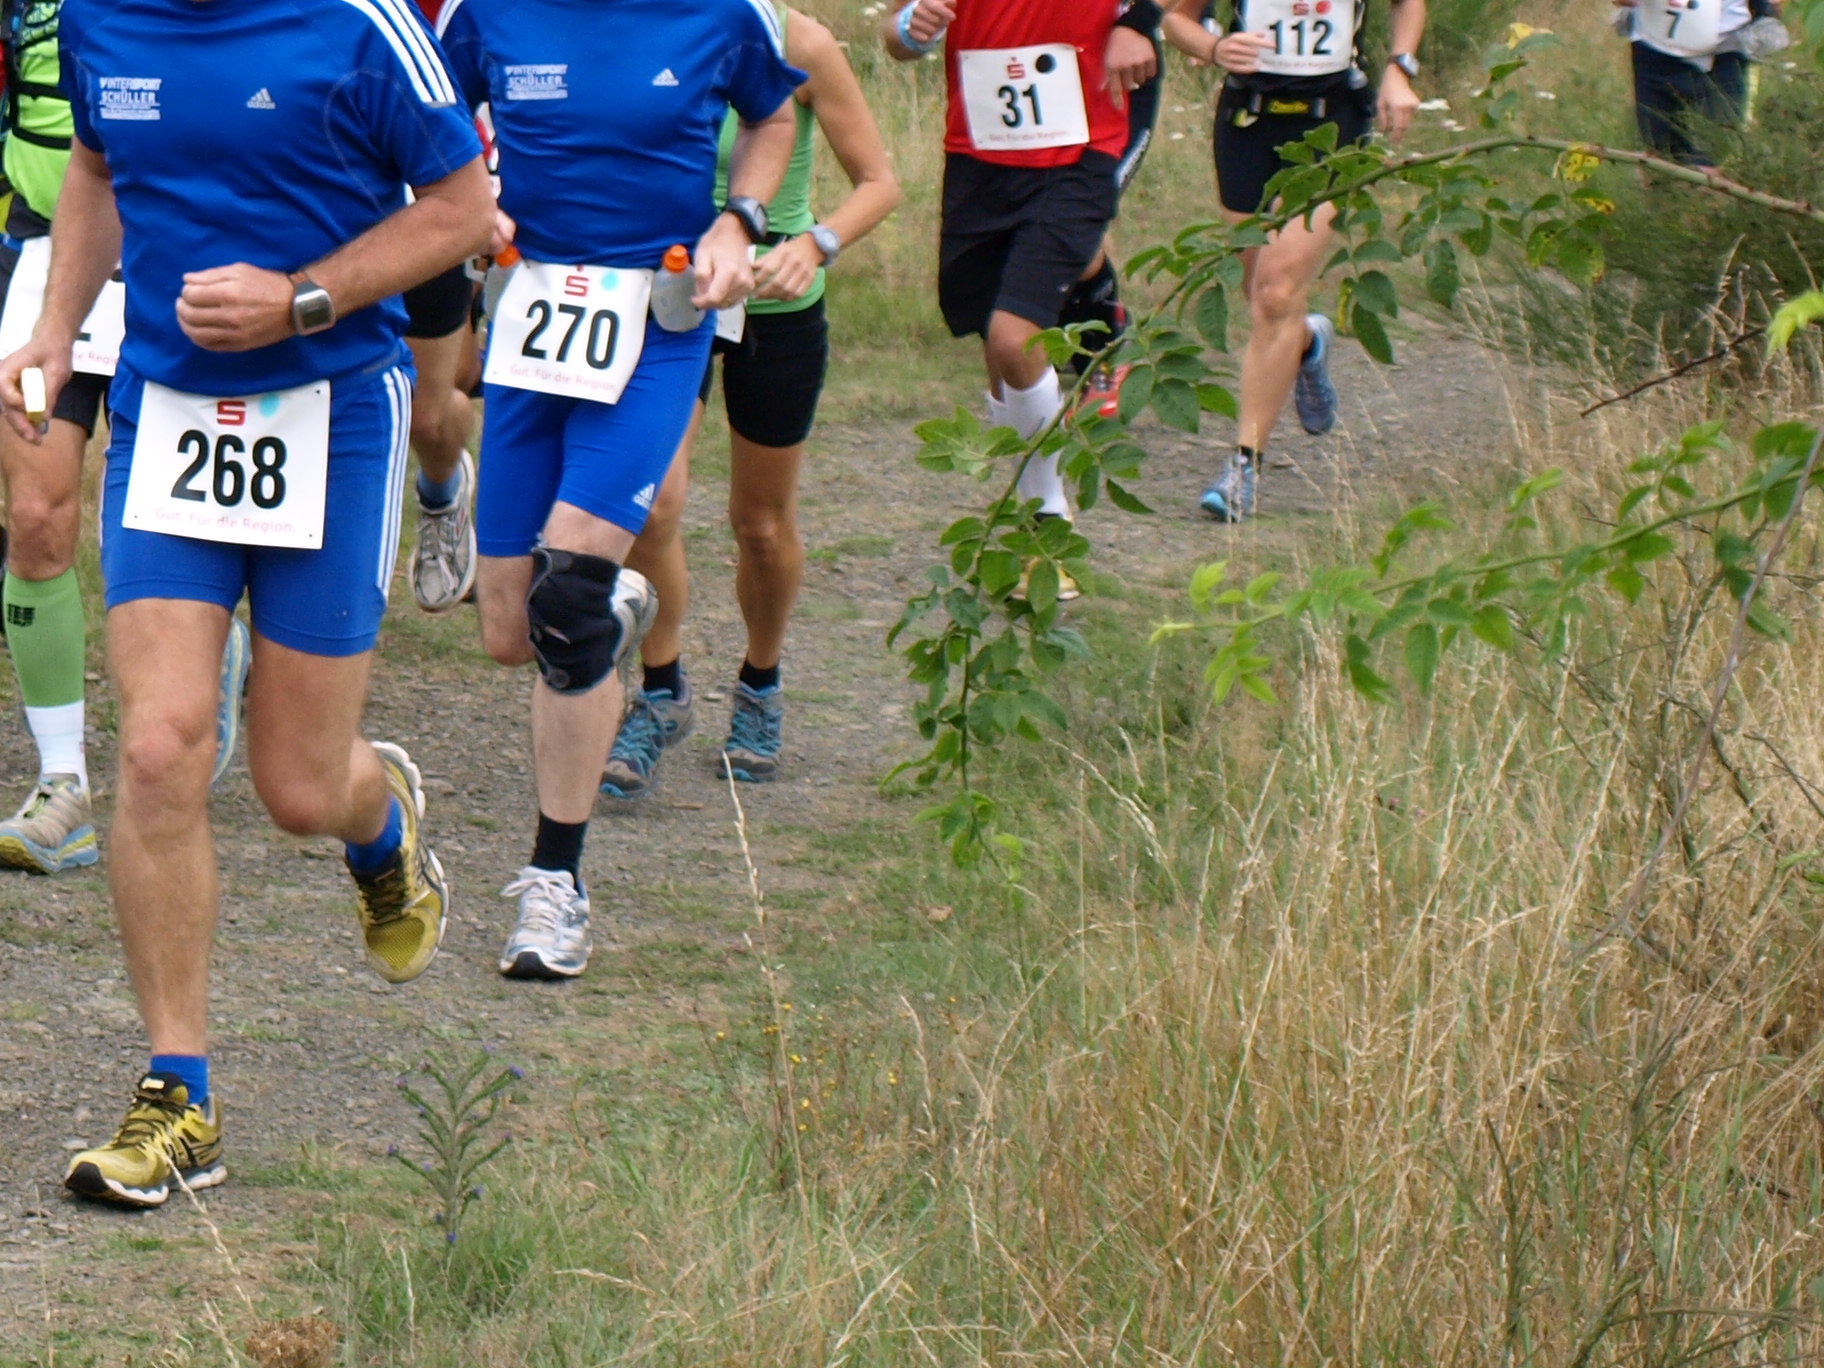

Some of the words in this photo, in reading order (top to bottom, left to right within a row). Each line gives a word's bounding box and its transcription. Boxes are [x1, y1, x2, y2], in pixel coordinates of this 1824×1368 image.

[1269, 19, 1333, 55] 112
[1666, 10, 1682, 38] 7
[101, 89, 156, 104] SCHÜLLER
[998, 83, 1043, 128] 31
[521, 299, 620, 371] 270
[170, 429, 287, 509] 268
